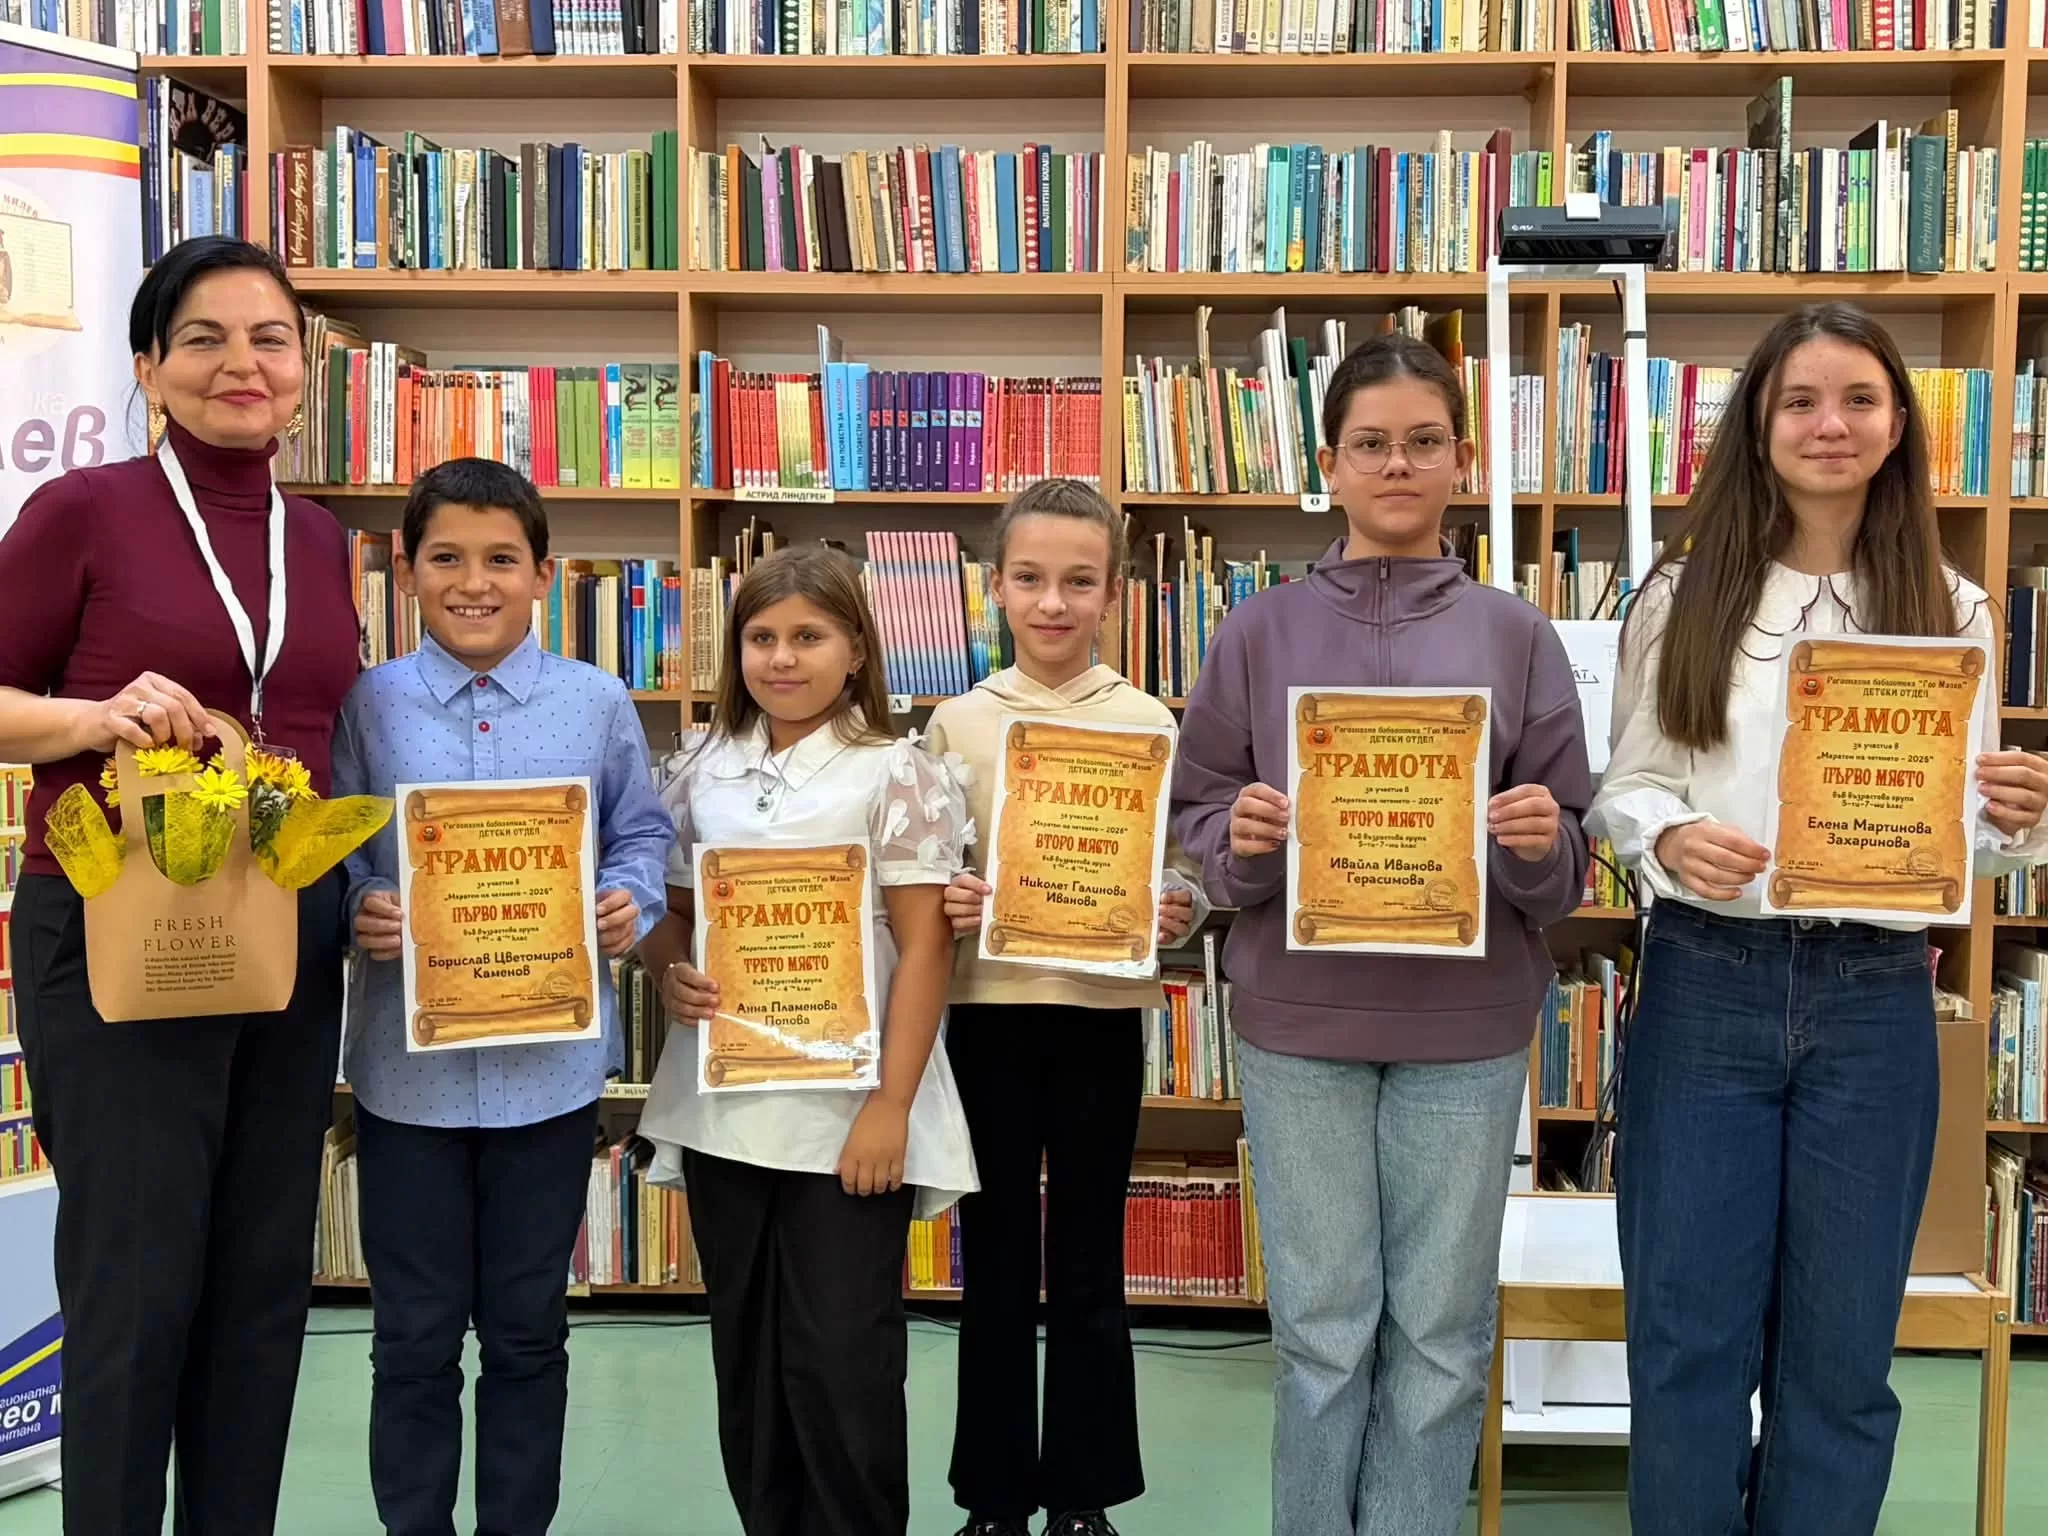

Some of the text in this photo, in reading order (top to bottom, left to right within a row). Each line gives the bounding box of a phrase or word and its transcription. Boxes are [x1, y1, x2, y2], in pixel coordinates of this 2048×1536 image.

[1041, 182, 1050, 228] ВАЛЕНТИН
[0, 404, 107, 475] ев
[745, 490, 827, 501] АСТРИД ЛИНДГРЕН
[1800, 705, 1955, 737] ГРАМОТА
[1313, 753, 1463, 780] ГРАМОТА
[1823, 766, 1925, 788] ПЪРВО МЯСТО
[1016, 778, 1145, 812] ГРАМОТА
[1339, 811, 1434, 828] ВТОРО МЯСТО
[1808, 817, 1933, 835] Елена Мартинова
[1035, 833, 1119, 855] ВТОРО МЯСТО
[1827, 833, 1911, 850] Захаринова
[424, 845, 568, 876] ГРАМОТА
[1330, 858, 1443, 872] Ивайла Иванова
[1019, 876, 1127, 896] Николет Галинова
[1347, 872, 1425, 887] Герасимова
[1046, 892, 1098, 907] Иванова
[452, 902, 547, 924] ПЪРВО МЯСТО
[719, 901, 850, 929] ГРАМОТА
[154, 915, 224, 932] FRESH
[144, 935, 237, 952] FLOWER
[428, 948, 574, 971] Борислав Цветомиров
[744, 955, 829, 973] ТРЕТО МЯСТО
[473, 965, 531, 979] Каменов
[736, 1000, 838, 1014] Анна Пламенова
[765, 1014, 810, 1026] Попова
